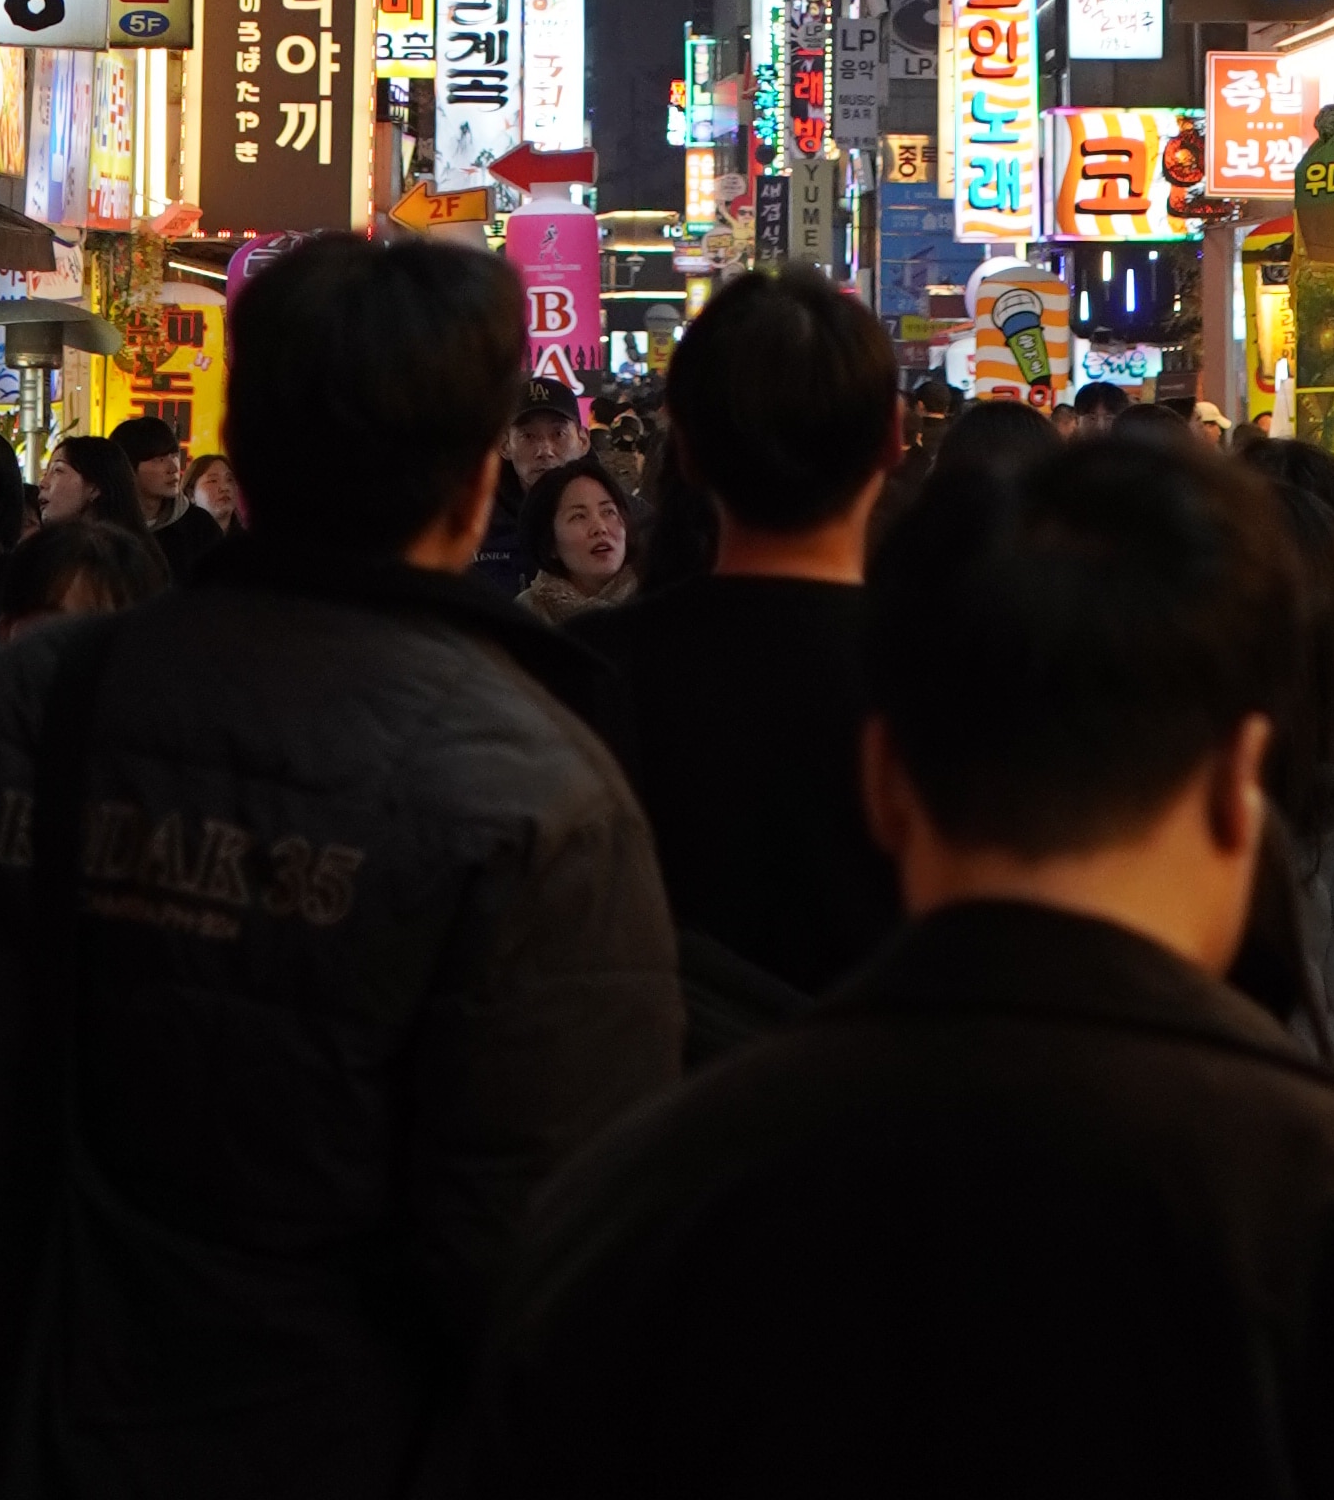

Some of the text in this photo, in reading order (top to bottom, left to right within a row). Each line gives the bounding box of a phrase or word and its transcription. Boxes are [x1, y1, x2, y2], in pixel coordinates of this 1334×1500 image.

[127, 15, 163, 33] 5F
[841, 29, 876, 52] LP
[839, 60, 876, 81] 음악
[1221, 71, 1304, 114] 족발
[842, 108, 872, 120] BAR
[1224, 139, 1306, 183] 보쌈
[428, 196, 461, 220] 2F
